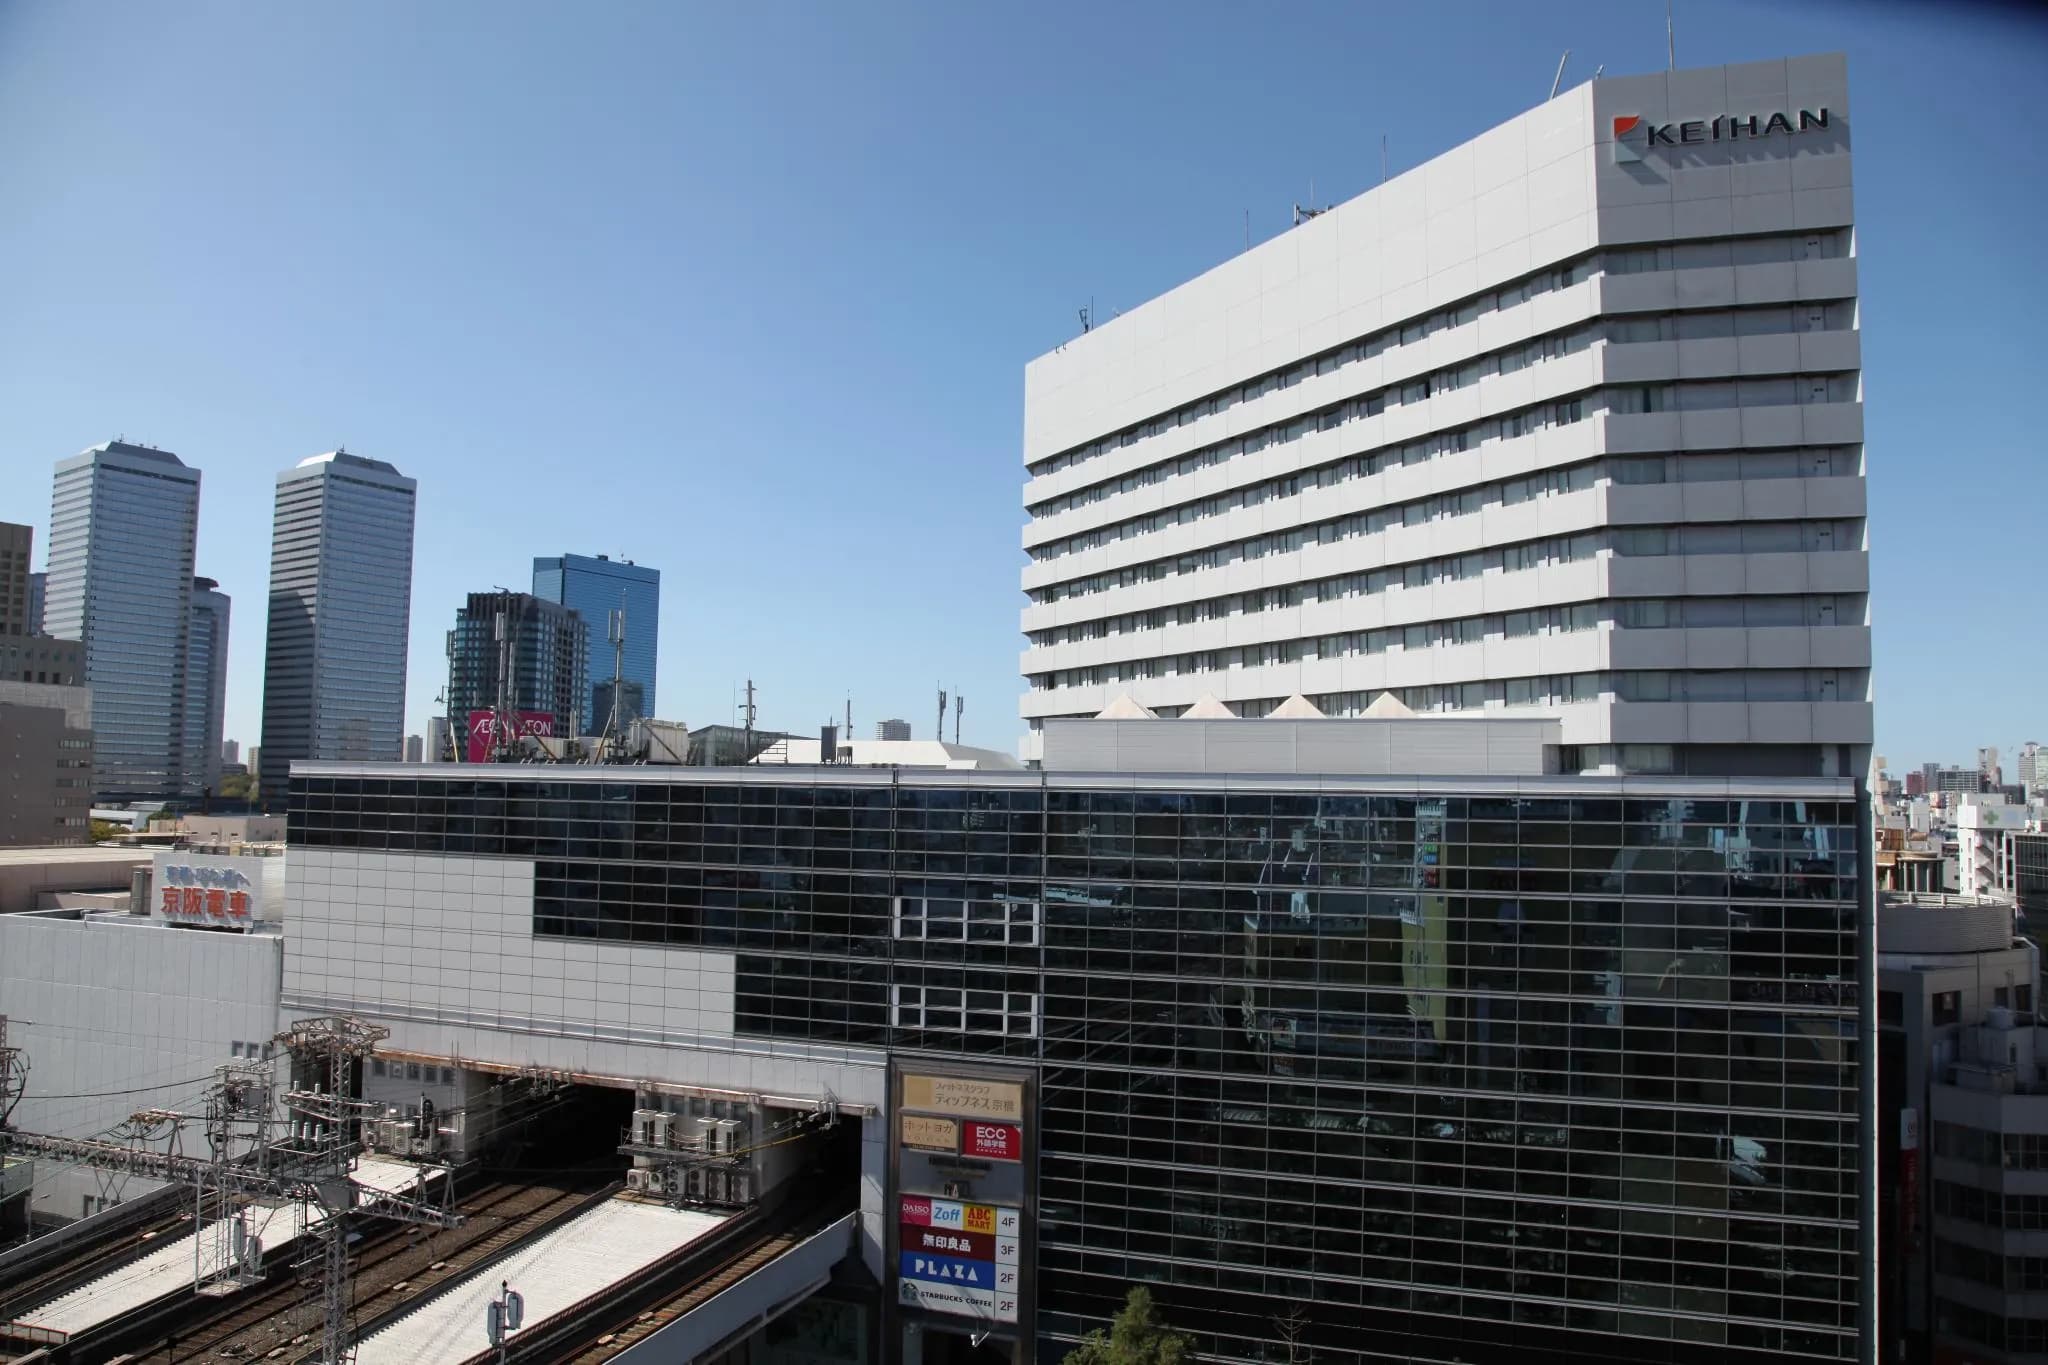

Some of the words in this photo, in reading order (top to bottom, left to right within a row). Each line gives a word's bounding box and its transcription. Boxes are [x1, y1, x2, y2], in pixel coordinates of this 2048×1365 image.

[1646, 107, 1829, 147] KEIHAN
[160, 885, 248, 918] 京阪電車
[976, 1126, 1007, 1140] ECC
[976, 1138, 1007, 1149] 外語学院
[902, 1203, 930, 1214] DAISO
[933, 1206, 961, 1221] Zoff
[967, 1207, 991, 1220] ABC
[967, 1220, 991, 1230] MART
[1001, 1217, 1016, 1228] 4F
[922, 1233, 972, 1253] 無印良品
[1000, 1245, 1015, 1256] 3F
[915, 1258, 978, 1282] PLAZA
[1000, 1272, 1015, 1283] 2F
[920, 1291, 963, 1303] STARBUCKS
[965, 1297, 993, 1308] COFFEE
[1000, 1300, 1015, 1312] 2F
